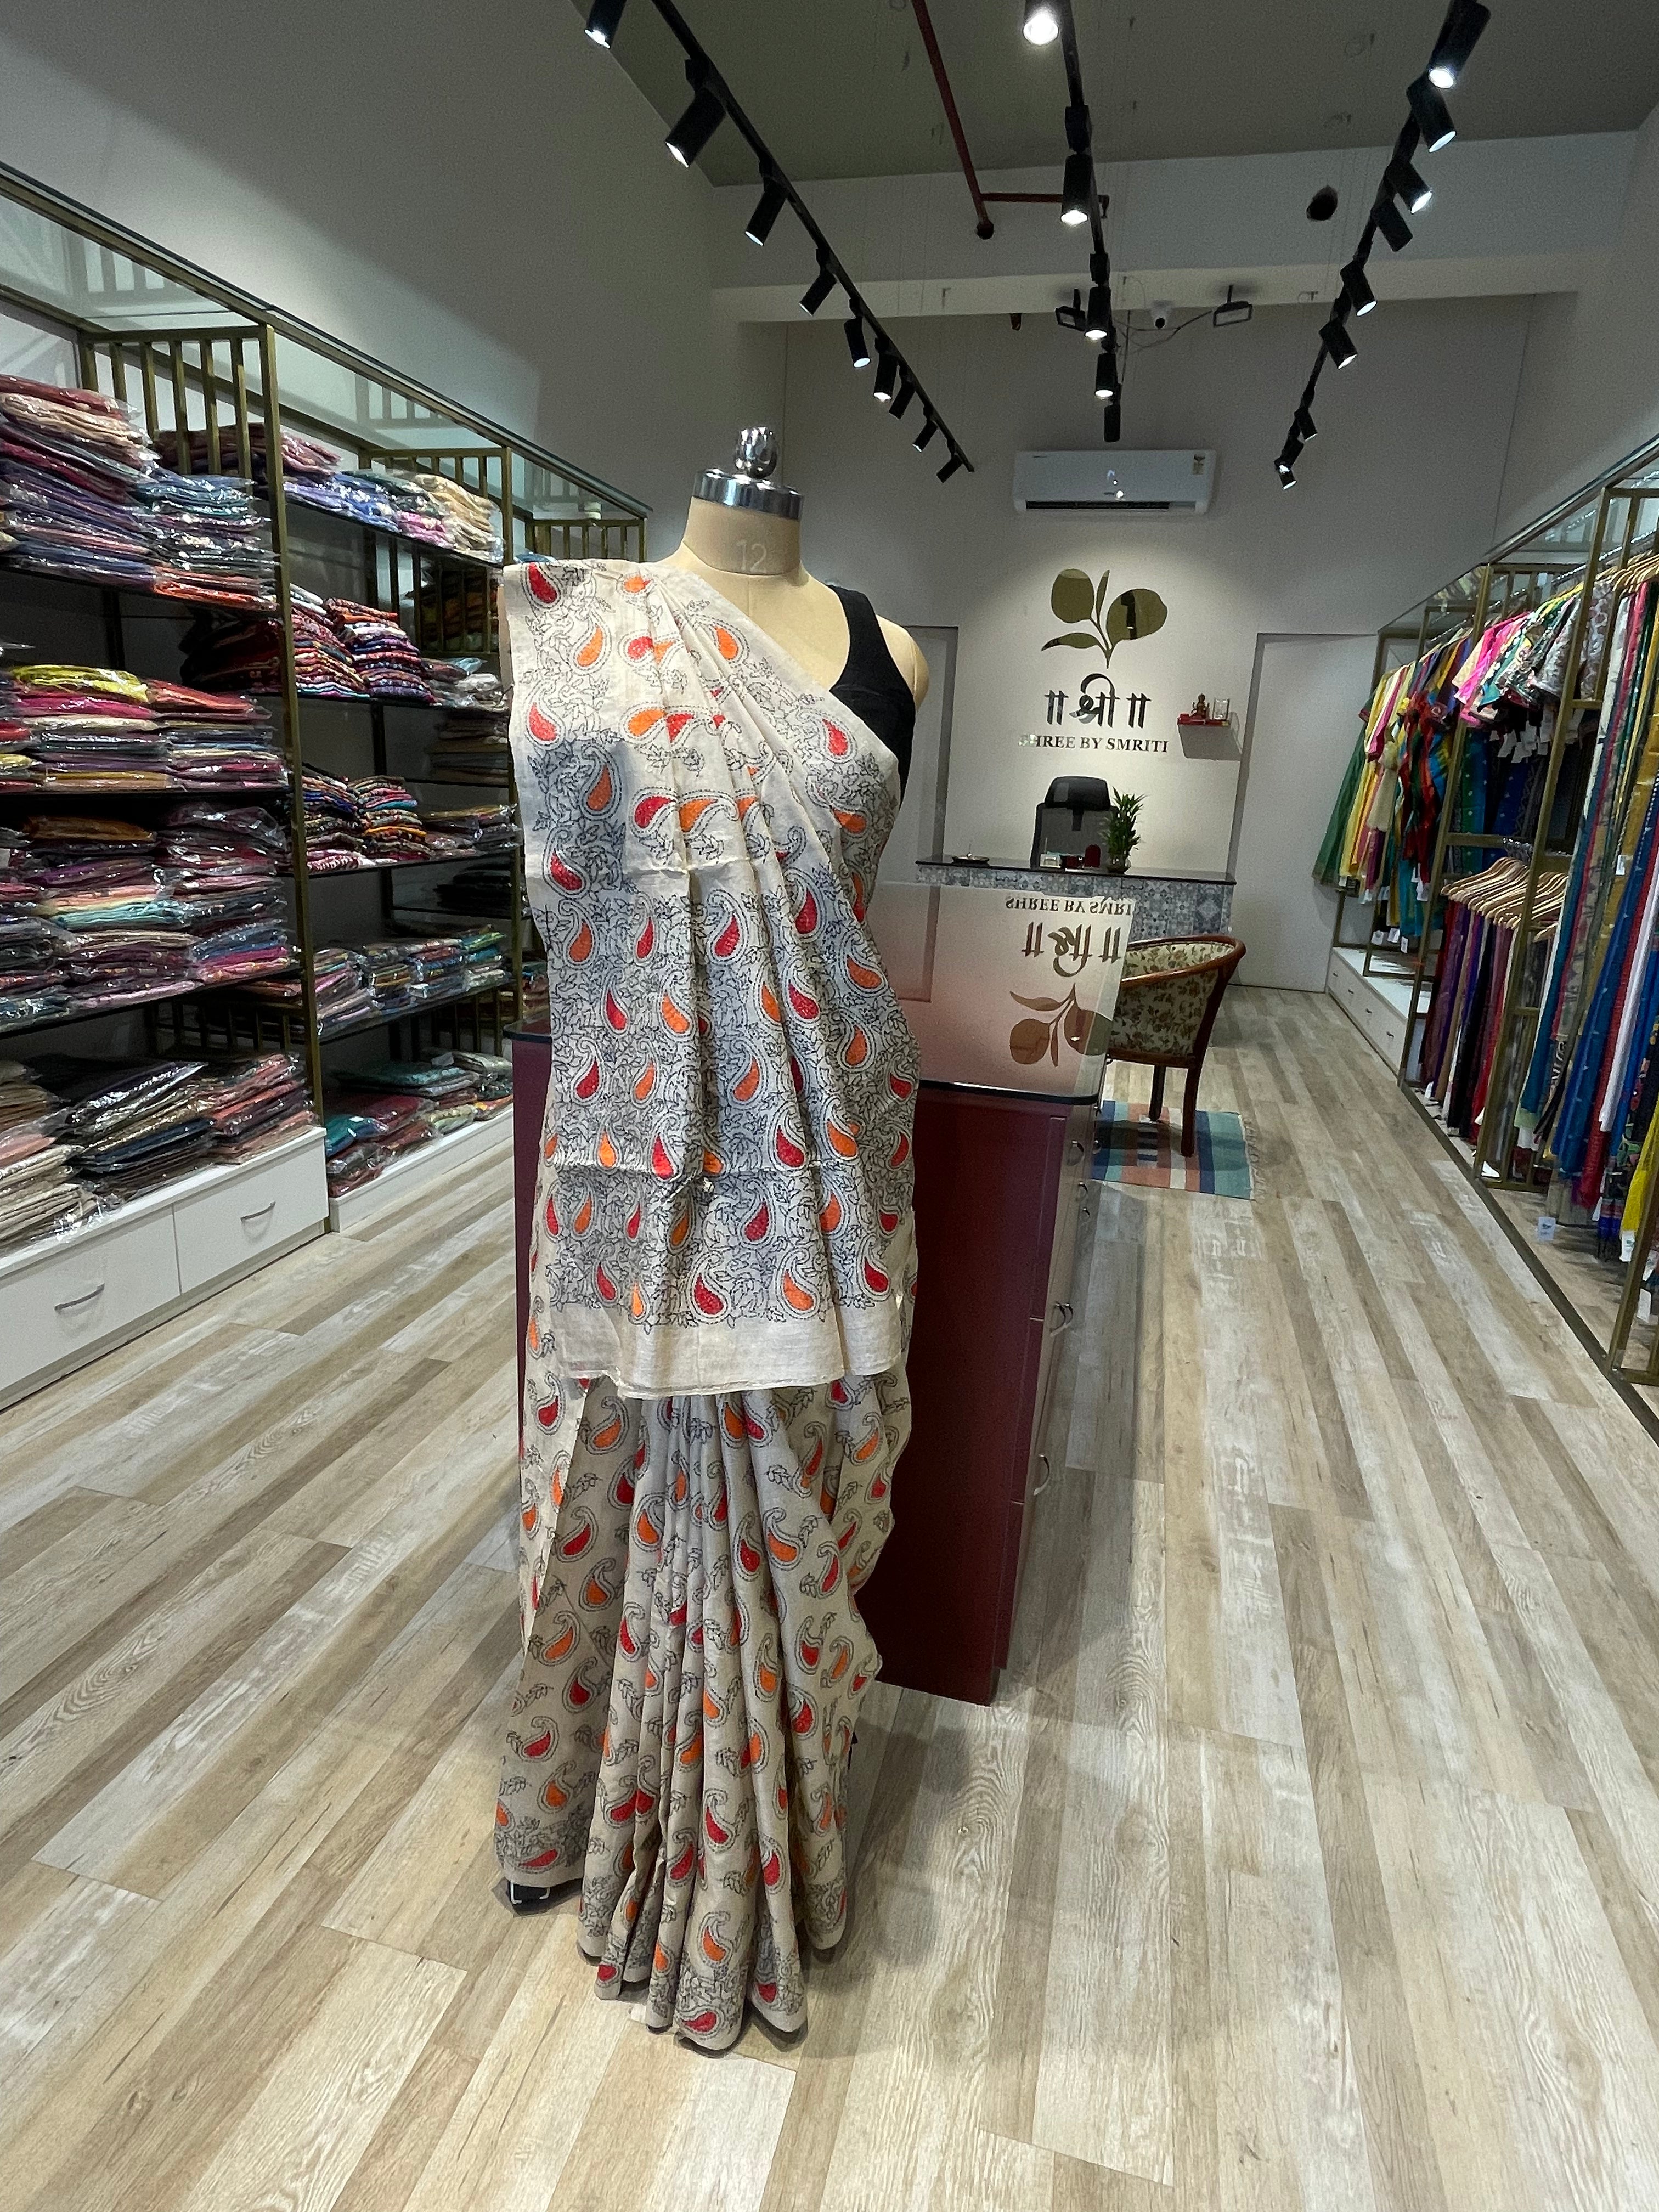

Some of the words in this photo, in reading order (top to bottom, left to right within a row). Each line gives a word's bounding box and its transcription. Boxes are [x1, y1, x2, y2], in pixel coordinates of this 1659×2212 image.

[736, 539, 768, 573] 12
[1080, 737, 1102, 750] BY
[1105, 738, 1169, 753] SMRITI
